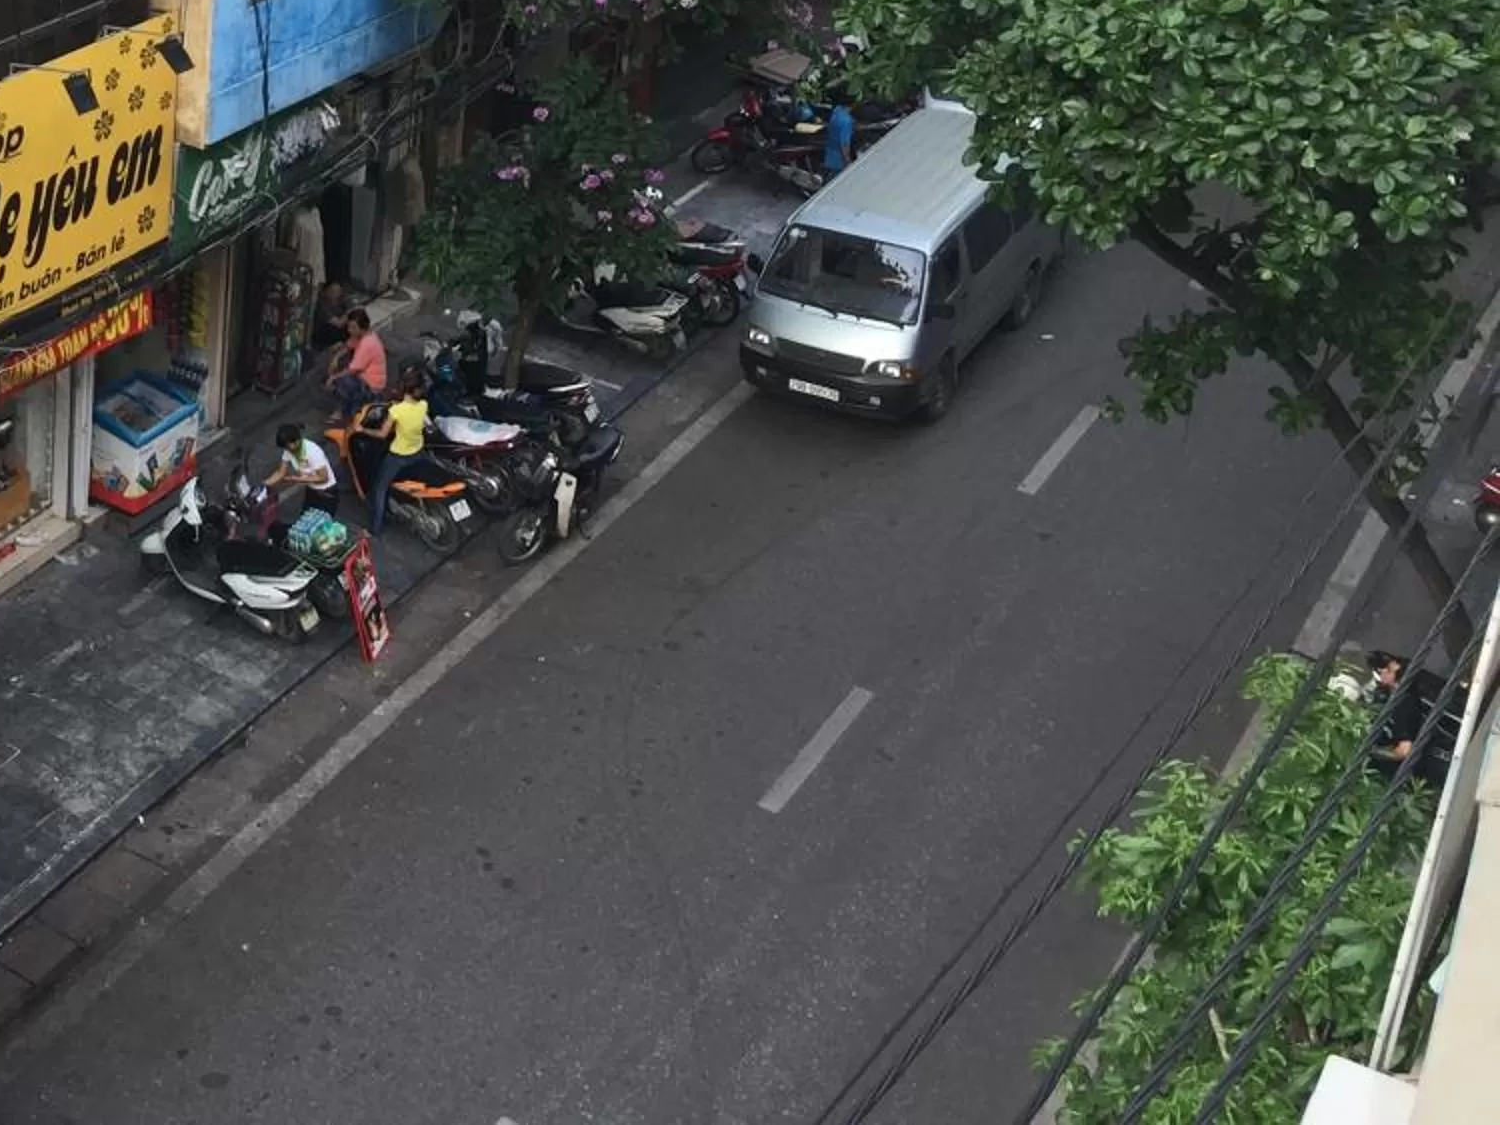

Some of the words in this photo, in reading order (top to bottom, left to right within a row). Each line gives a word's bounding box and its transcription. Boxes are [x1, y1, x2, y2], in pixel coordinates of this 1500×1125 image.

[23, 145, 99, 268] yêu
[107, 124, 163, 205] em
[76, 243, 107, 272] Bán
